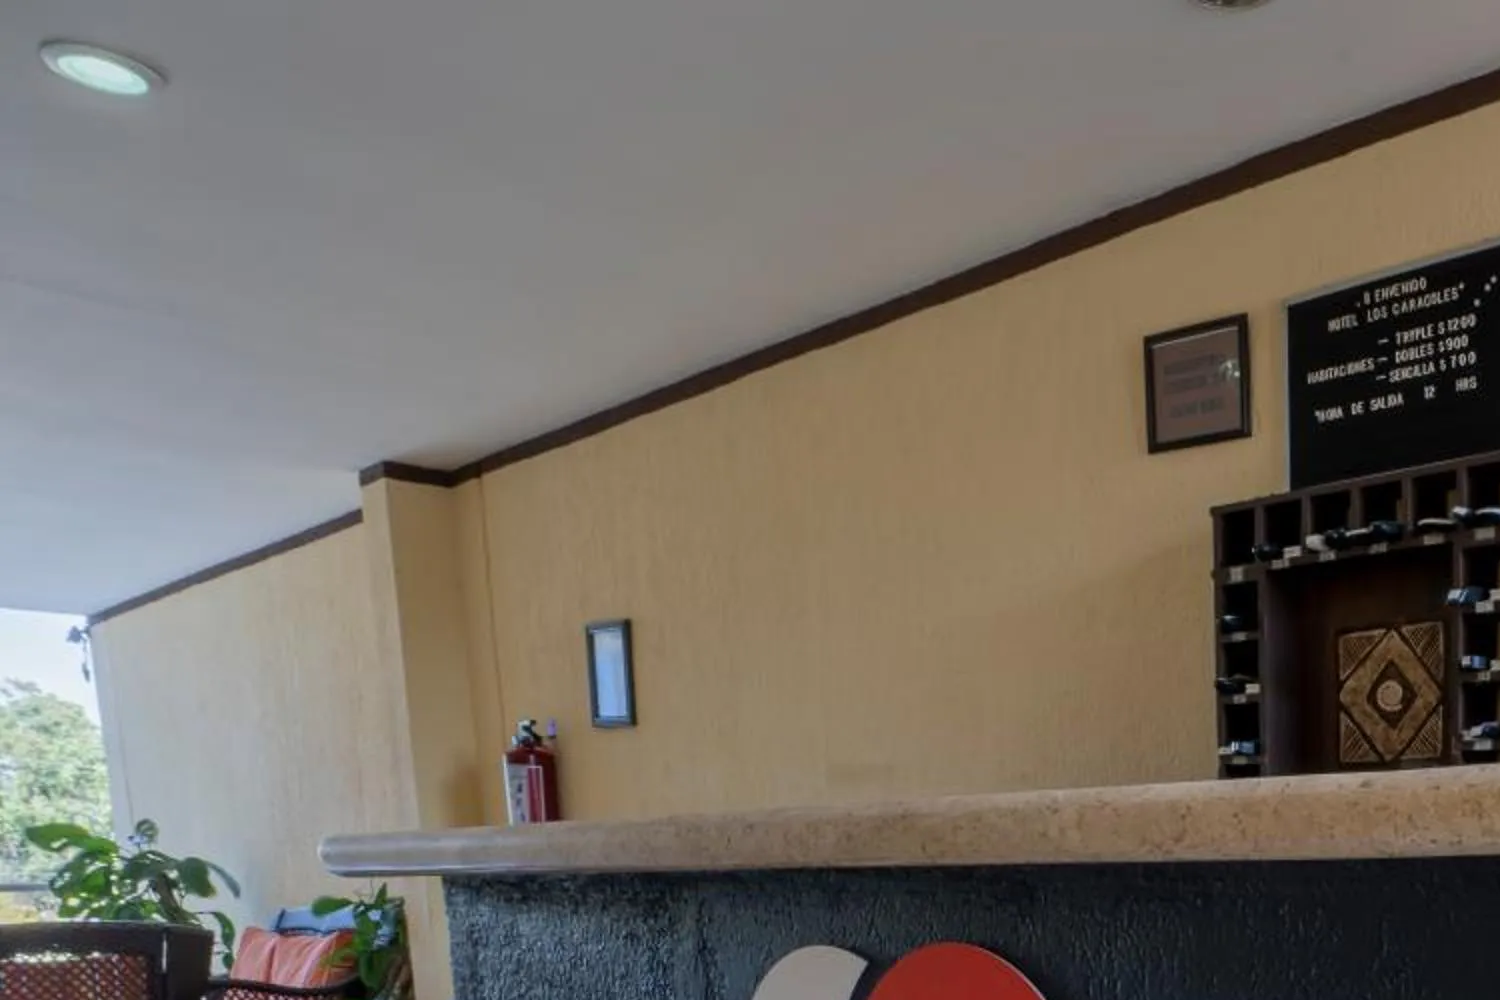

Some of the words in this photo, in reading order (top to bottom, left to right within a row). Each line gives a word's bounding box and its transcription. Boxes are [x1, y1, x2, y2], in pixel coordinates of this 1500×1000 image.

[1327, 314, 1359, 333] HOTEL
[1366, 304, 1389, 324] LOS
[1395, 321, 1435, 346] TRIPLE
[1395, 340, 1435, 364] DOBLES
[1388, 362, 1436, 384] SENCILLA
[1350, 402, 1365, 416] DE
[1369, 393, 1405, 412] SALIDA
[1423, 384, 1436, 400] 12
[1454, 375, 1478, 392] HRS
